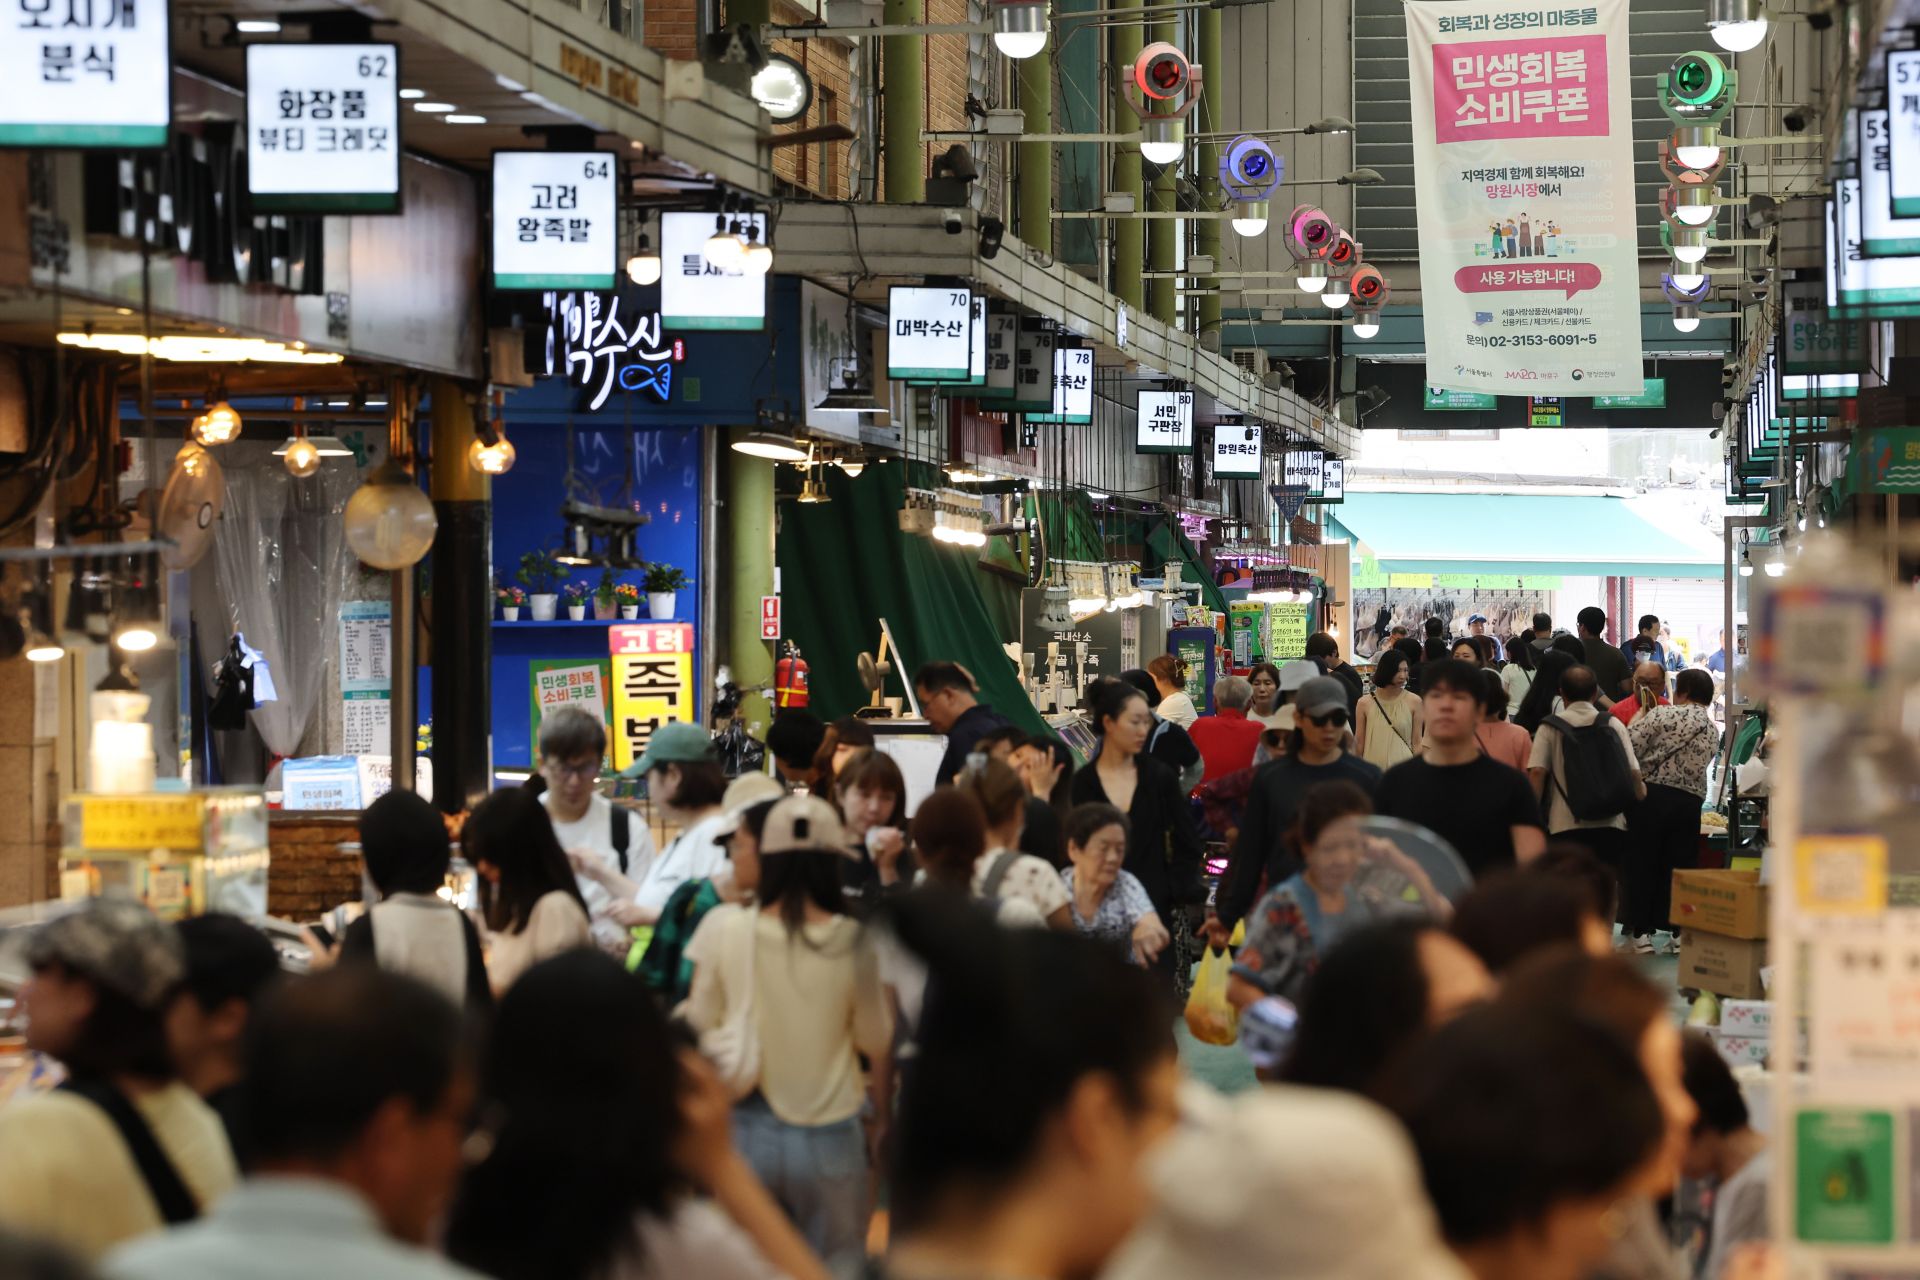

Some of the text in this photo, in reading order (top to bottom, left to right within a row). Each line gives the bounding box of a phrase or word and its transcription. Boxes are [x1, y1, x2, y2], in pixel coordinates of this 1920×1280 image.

[1437, 7, 1598, 33] 회복과 성장의 마중물
[42, 45, 114, 82] 분식
[358, 55, 388, 78] 62
[1452, 49, 1588, 91] 민생회복
[279, 89, 366, 119] 화장품
[1454, 87, 1590, 128] 소비쿠폰
[260, 127, 388, 151] 뷰티 크레딧
[584, 161, 608, 179] 64
[1461, 165, 1585, 182] 지역경제 함께 회복해요!
[530, 184, 577, 209] 고려
[1485, 183, 1562, 199] 망원시장에서
[518, 217, 592, 242] 왕족발
[1479, 269, 1576, 286] 사용 가능합니다!
[950, 293, 967, 307] 70
[895, 319, 963, 338] 대박수산
[998, 318, 1014, 331] 74
[1501, 318, 1529, 327] 신용카드
[1035, 335, 1050, 348] 76
[1489, 333, 1597, 347] 02-3153-6091~5
[1076, 353, 1090, 364] 78
[1179, 395, 1191, 405] 80
[1154, 405, 1177, 418] 서민
[1148, 420, 1183, 433] 구판장
[1217, 444, 1258, 455] 망원축산
[619, 629, 684, 653] 고려
[1053, 631, 1092, 642] 국내산 소
[1044, 654, 1068, 667] 골
[541, 671, 595, 690] 민생회복
[543, 684, 597, 704] 소비쿠폰
